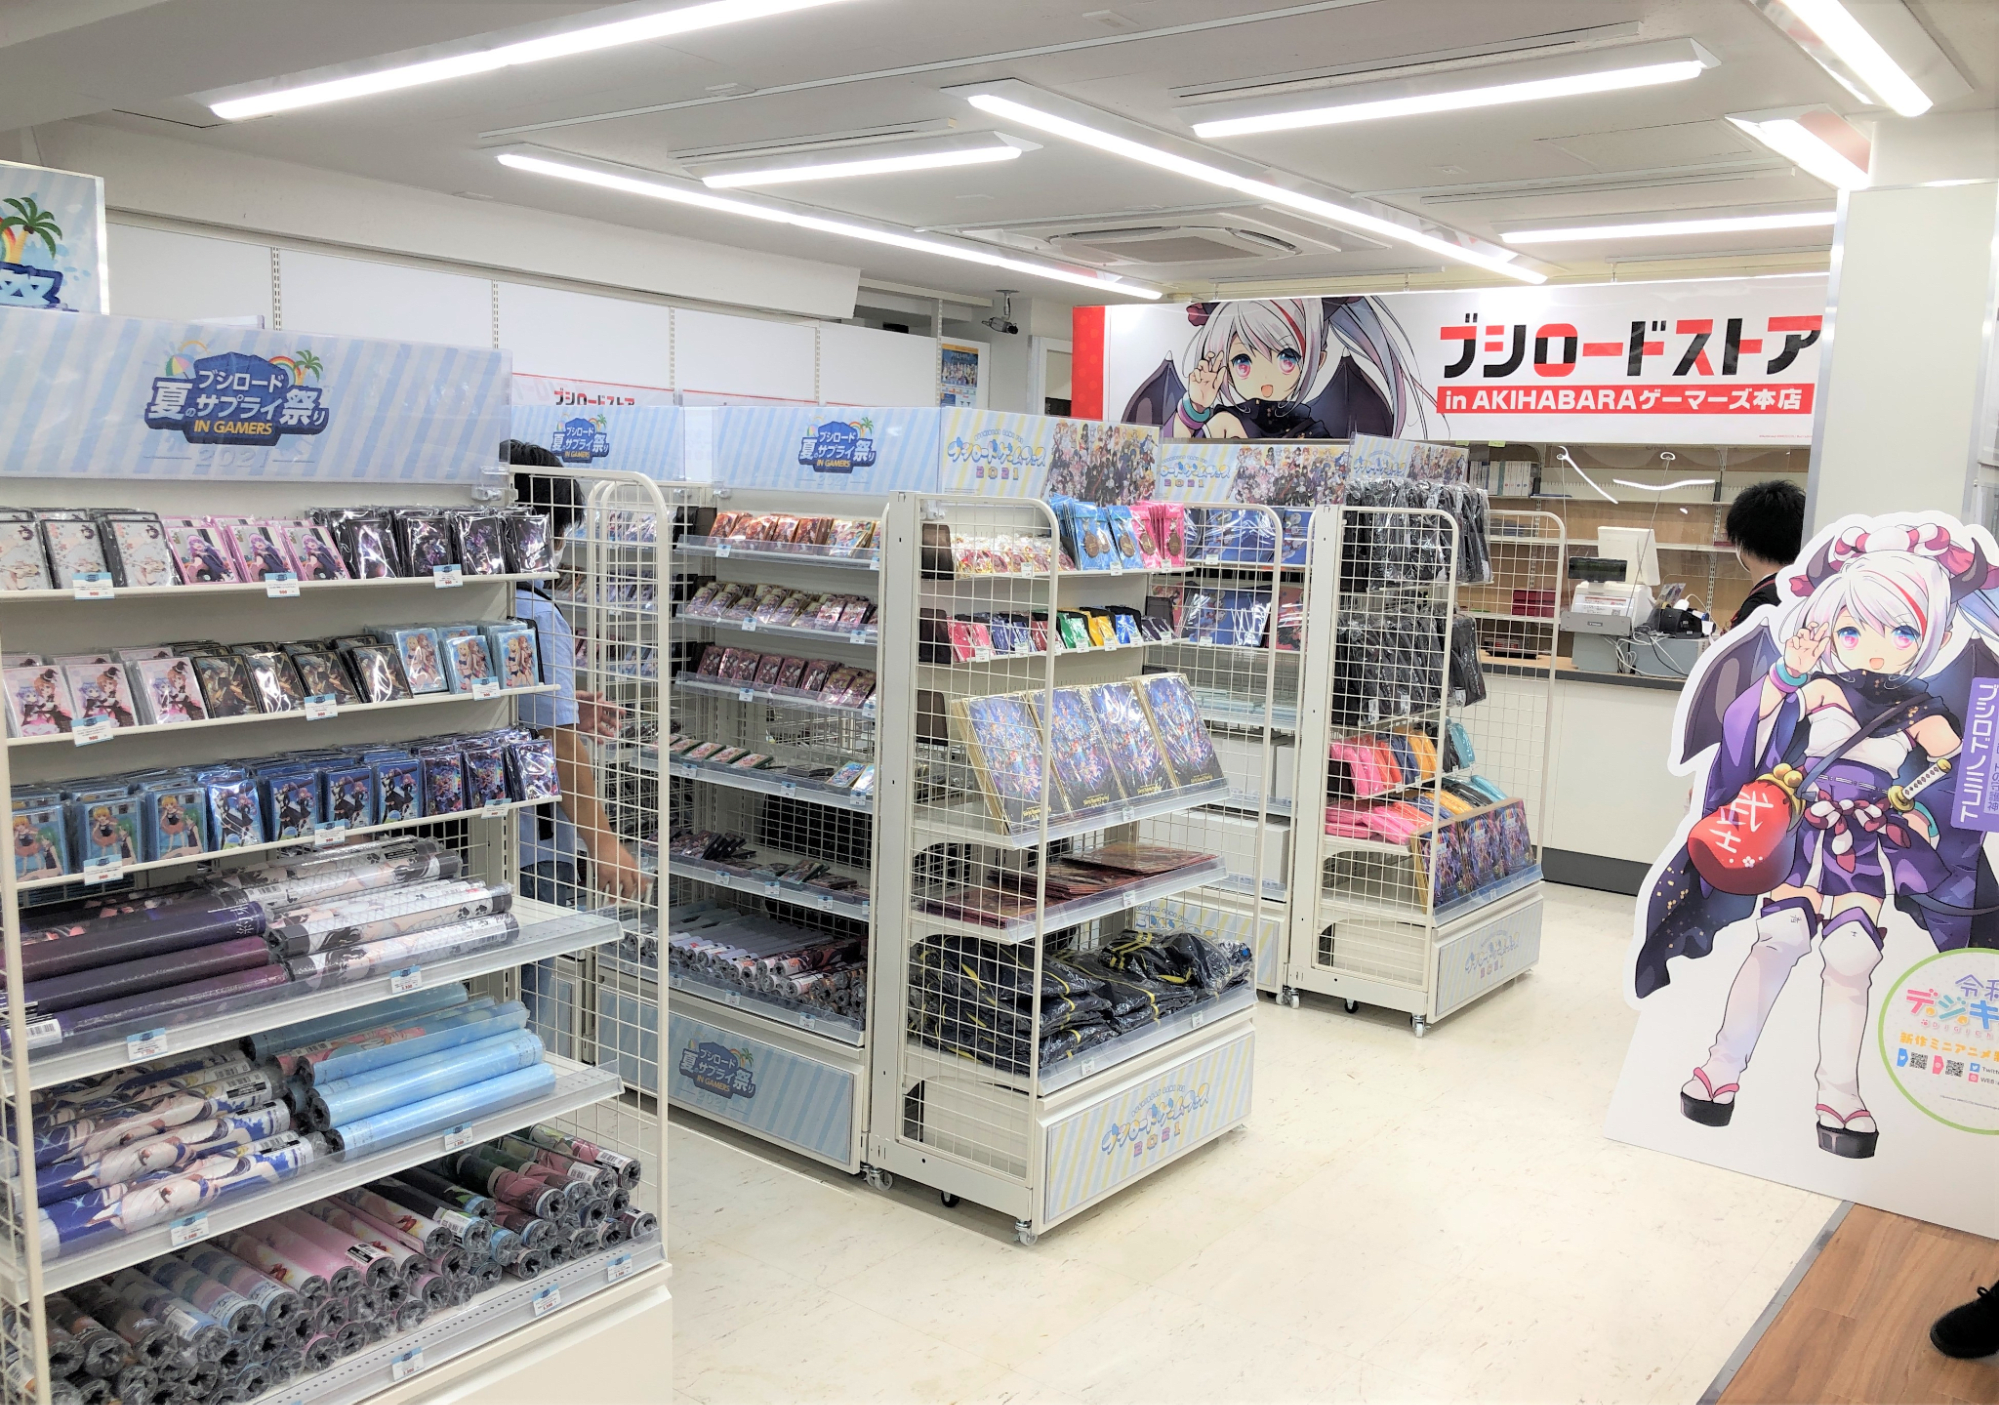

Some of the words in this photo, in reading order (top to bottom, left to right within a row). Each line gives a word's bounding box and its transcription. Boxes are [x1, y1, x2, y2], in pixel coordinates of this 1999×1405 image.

[1440, 313, 1823, 379] ブシロードストア
[199, 369, 284, 393] ブシロード
[148, 381, 326, 426] 夏のサプライ祭り
[1445, 390, 1467, 410] in
[1472, 388, 1803, 412] AKIHABARAゲーマーズ本店
[194, 420, 211, 433] IN
[213, 421, 273, 435] GAMERS
[820, 432, 856, 443] ブシロード
[976, 465, 1019, 480] 2021
[1709, 790, 1775, 854] 武士
[699, 1048, 736, 1068] ブシロード
[680, 1050, 755, 1094] 夏のサプライ祭り
[1133, 1121, 1181, 1158] 2021
